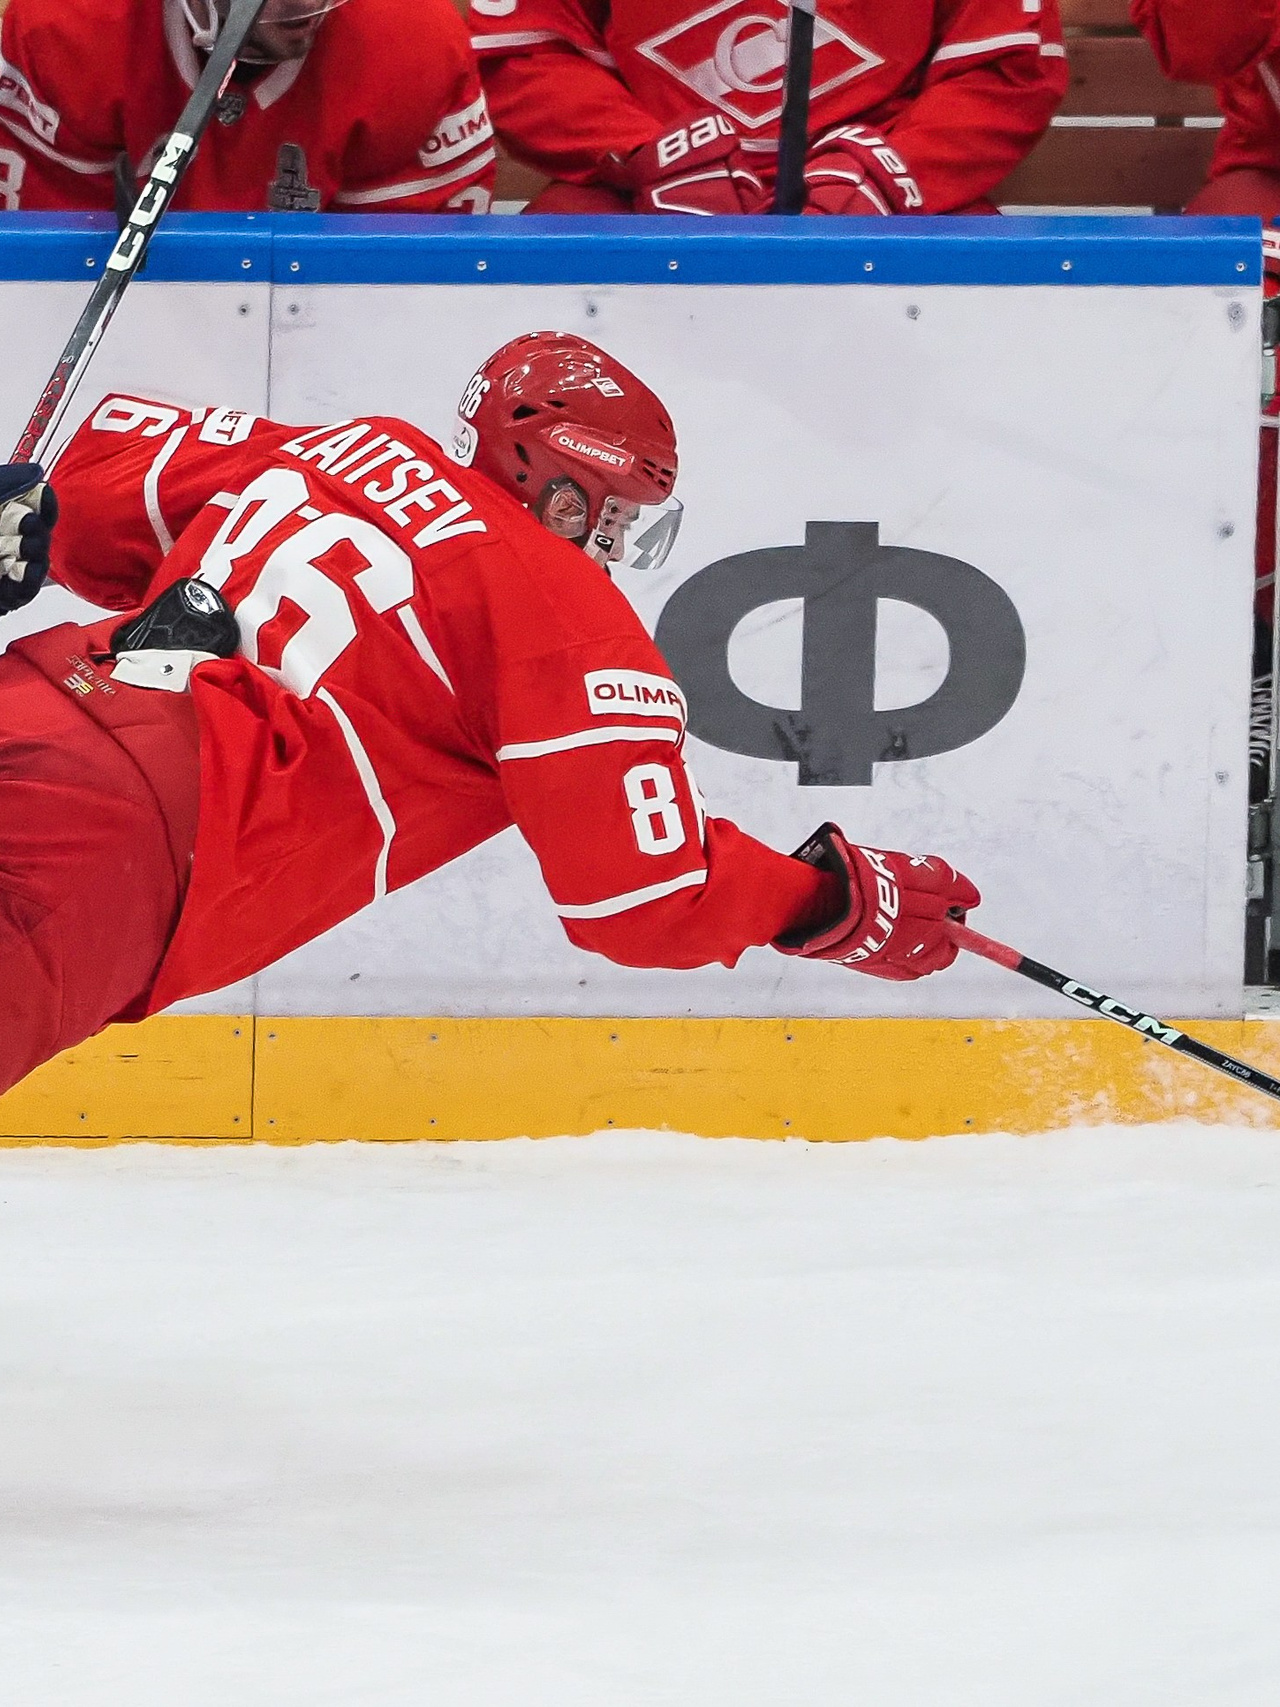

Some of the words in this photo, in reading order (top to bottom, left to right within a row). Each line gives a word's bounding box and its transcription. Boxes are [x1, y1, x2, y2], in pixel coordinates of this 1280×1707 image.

[106, 133, 194, 272] CCM
[458, 373, 492, 419] 86
[278, 419, 488, 549] ZAITSEV
[557, 434, 628, 468] OLIMPBET
[654, 520, 1027, 787] Ф
[1061, 978, 1184, 1047] CCM
